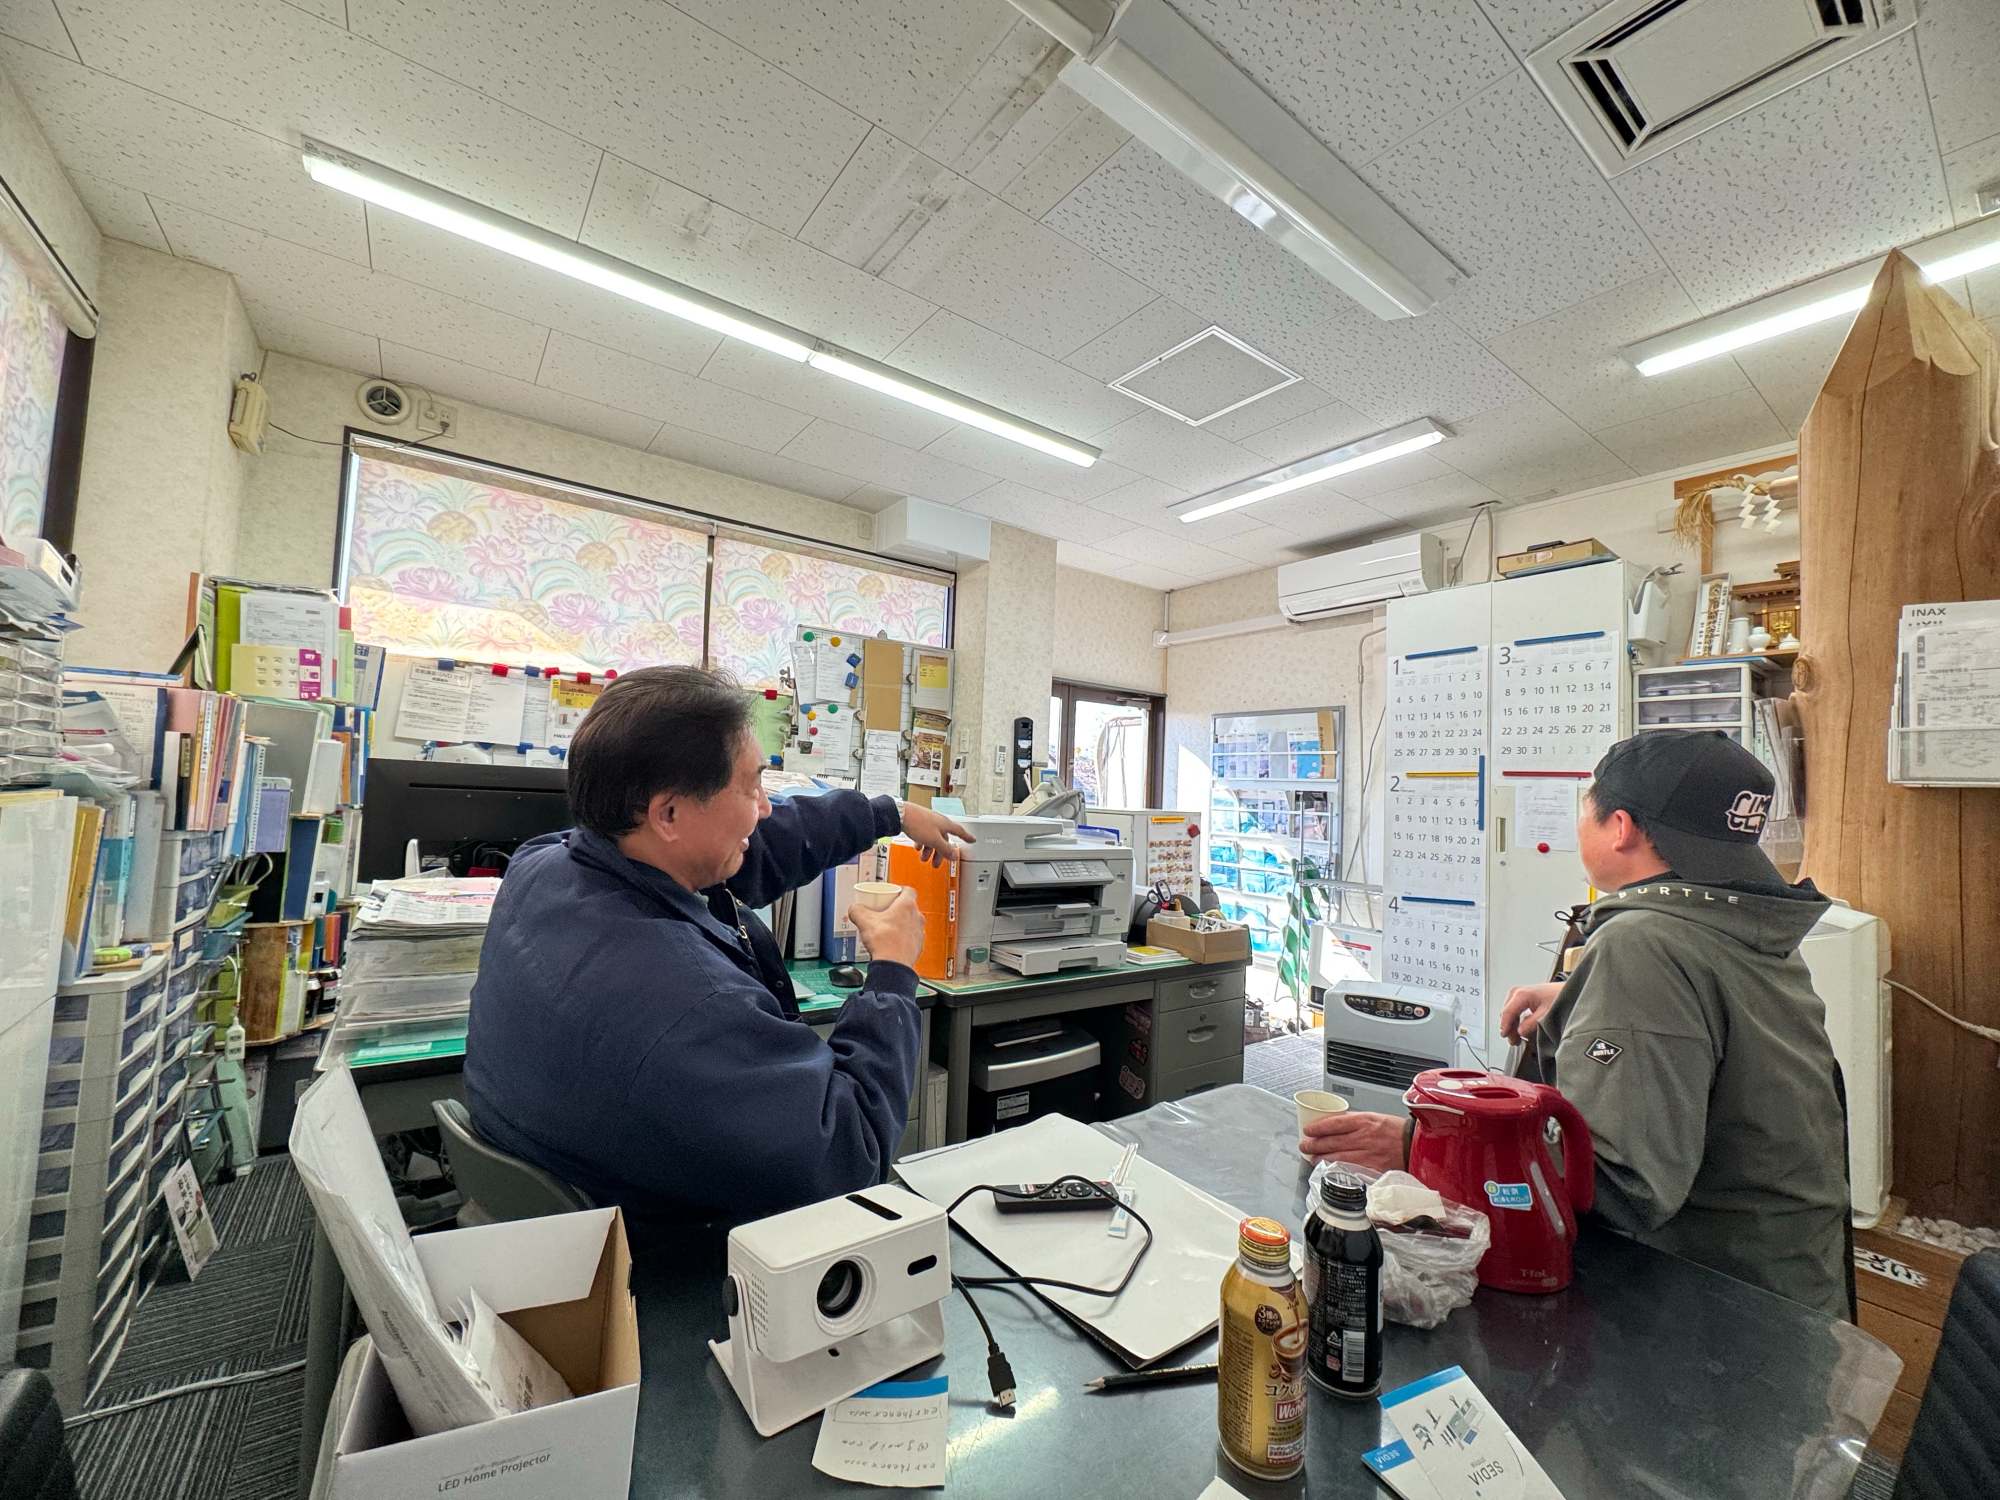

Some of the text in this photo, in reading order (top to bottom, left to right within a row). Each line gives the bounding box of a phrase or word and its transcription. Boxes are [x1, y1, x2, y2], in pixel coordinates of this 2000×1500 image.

[1911, 607, 1947, 617] INAX
[1499, 647, 1511, 664] 3
[1393, 659, 1399, 675] 1
[1521, 668, 1526, 676] 2
[1536, 667, 1542, 675] 3
[1569, 664, 1574, 672] 5
[1603, 662, 1609, 670] 7
[1551, 686, 1559, 694] 11
[1567, 685, 1576, 693] 12
[1584, 683, 1593, 691] 13
[1601, 682, 1611, 690] 14
[1435, 694, 1439, 702] 7
[1504, 708, 1512, 716] 15
[1519, 707, 1528, 715] 16
[1550, 706, 1560, 714] 18
[1567, 705, 1576, 713] 19
[1582, 704, 1593, 712] 20
[1600, 704, 1610, 712] 21
[1459, 729, 1467, 737] 23
[1517, 727, 1527, 735] 23
[1549, 726, 1559, 734] 25
[1582, 725, 1593, 733] 27
[1600, 724, 1611, 733] 28
[1390, 776, 1399, 792] 2
[1444, 854, 1452, 862] 26
[1618, 886, 1739, 904] BURTLE
[1389, 896, 1399, 913] 4
[1444, 925, 1449, 933] 2
[1472, 929, 1477, 937] 4
[1456, 947, 1465, 955] 10
[1470, 949, 1478, 957] 11
[1391, 954, 1479, 976] 12 13 14 15 16 17 18
[1391, 971, 1480, 996] 19 20 21 22 23 24 25
[1375, 1449, 1400, 1464] SEDIA
[437, 1479, 460, 1492] LED
[464, 1469, 497, 1484] Home
[501, 1453, 551, 1475] Projector
[1467, 1460, 1504, 1486] SEDIA
